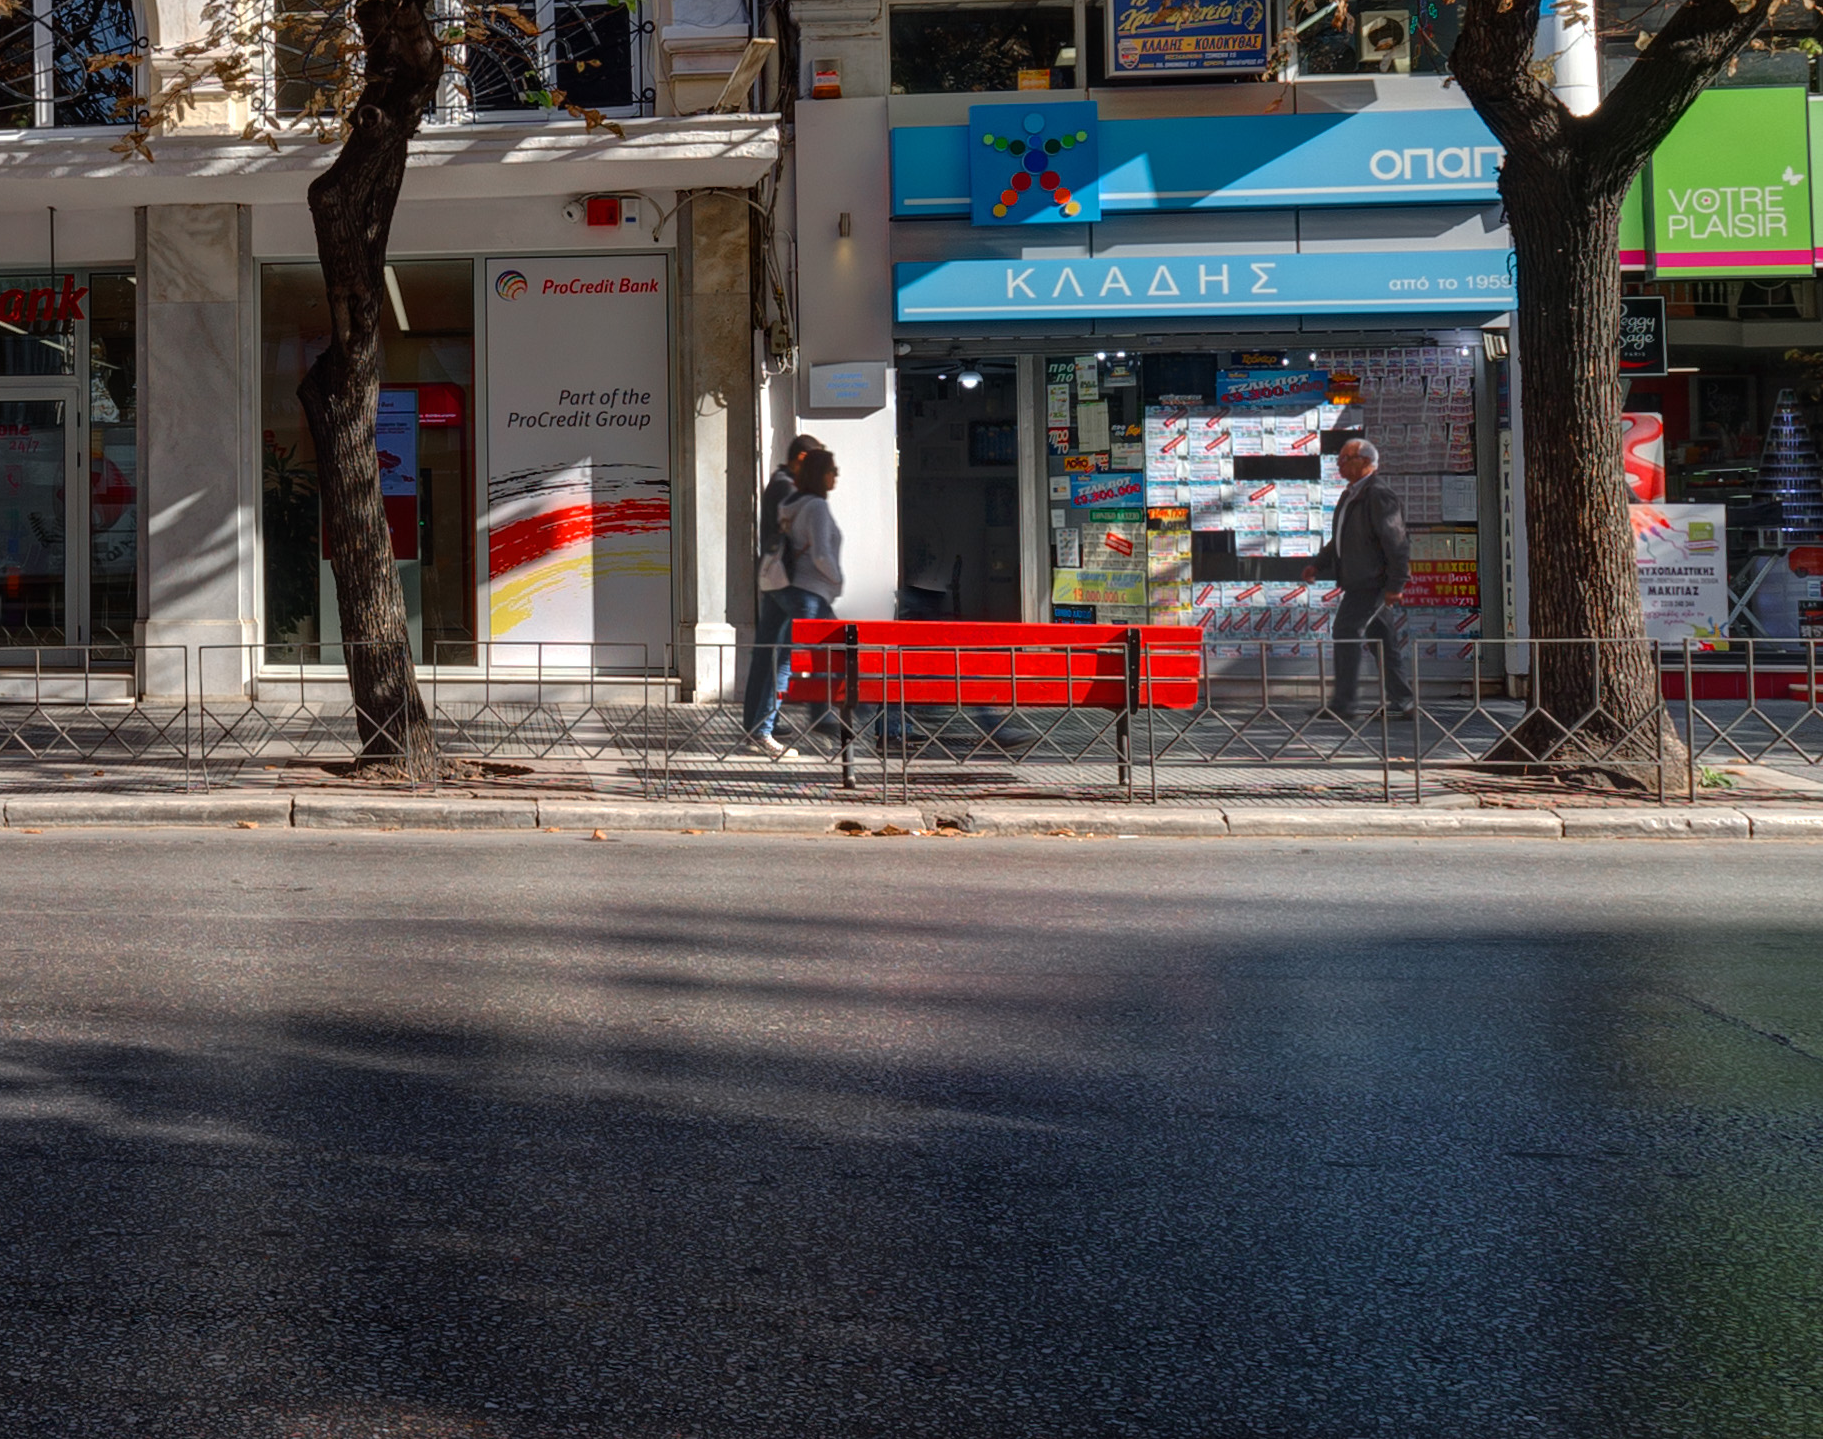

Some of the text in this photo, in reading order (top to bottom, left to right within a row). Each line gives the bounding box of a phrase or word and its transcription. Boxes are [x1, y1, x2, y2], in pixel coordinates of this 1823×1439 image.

[1141, 38, 1185, 53] ΚΛΑΔΗΣ
[1194, 35, 1260, 51] ΚΟΛΟΚΥΘΑΣ
[1667, 185, 1785, 219] VOTRE
[1667, 212, 1787, 240] PLAISIR
[542, 278, 659, 295] ProCredit Bank
[1006, 261, 1512, 300] ΚΛΑΔΗΣ από το 1959
[1048, 363, 1075, 374] ΠΡΟ
[1227, 373, 1310, 394] ΤΖΑΚ ΠΟΤ
[559, 388, 651, 408] Part of the
[507, 411, 651, 431] ProCredit Group
[9, 437, 40, 454] 24/7
[1078, 476, 1132, 496] ΤΖΑΚ ΠΟΤ
[1638, 567, 1715, 576] ΝΥΧΟΠΛΑΣΤΙΚΗΣ
[1647, 585, 1700, 596] ΜΑΚΙΓΙΑΖ
